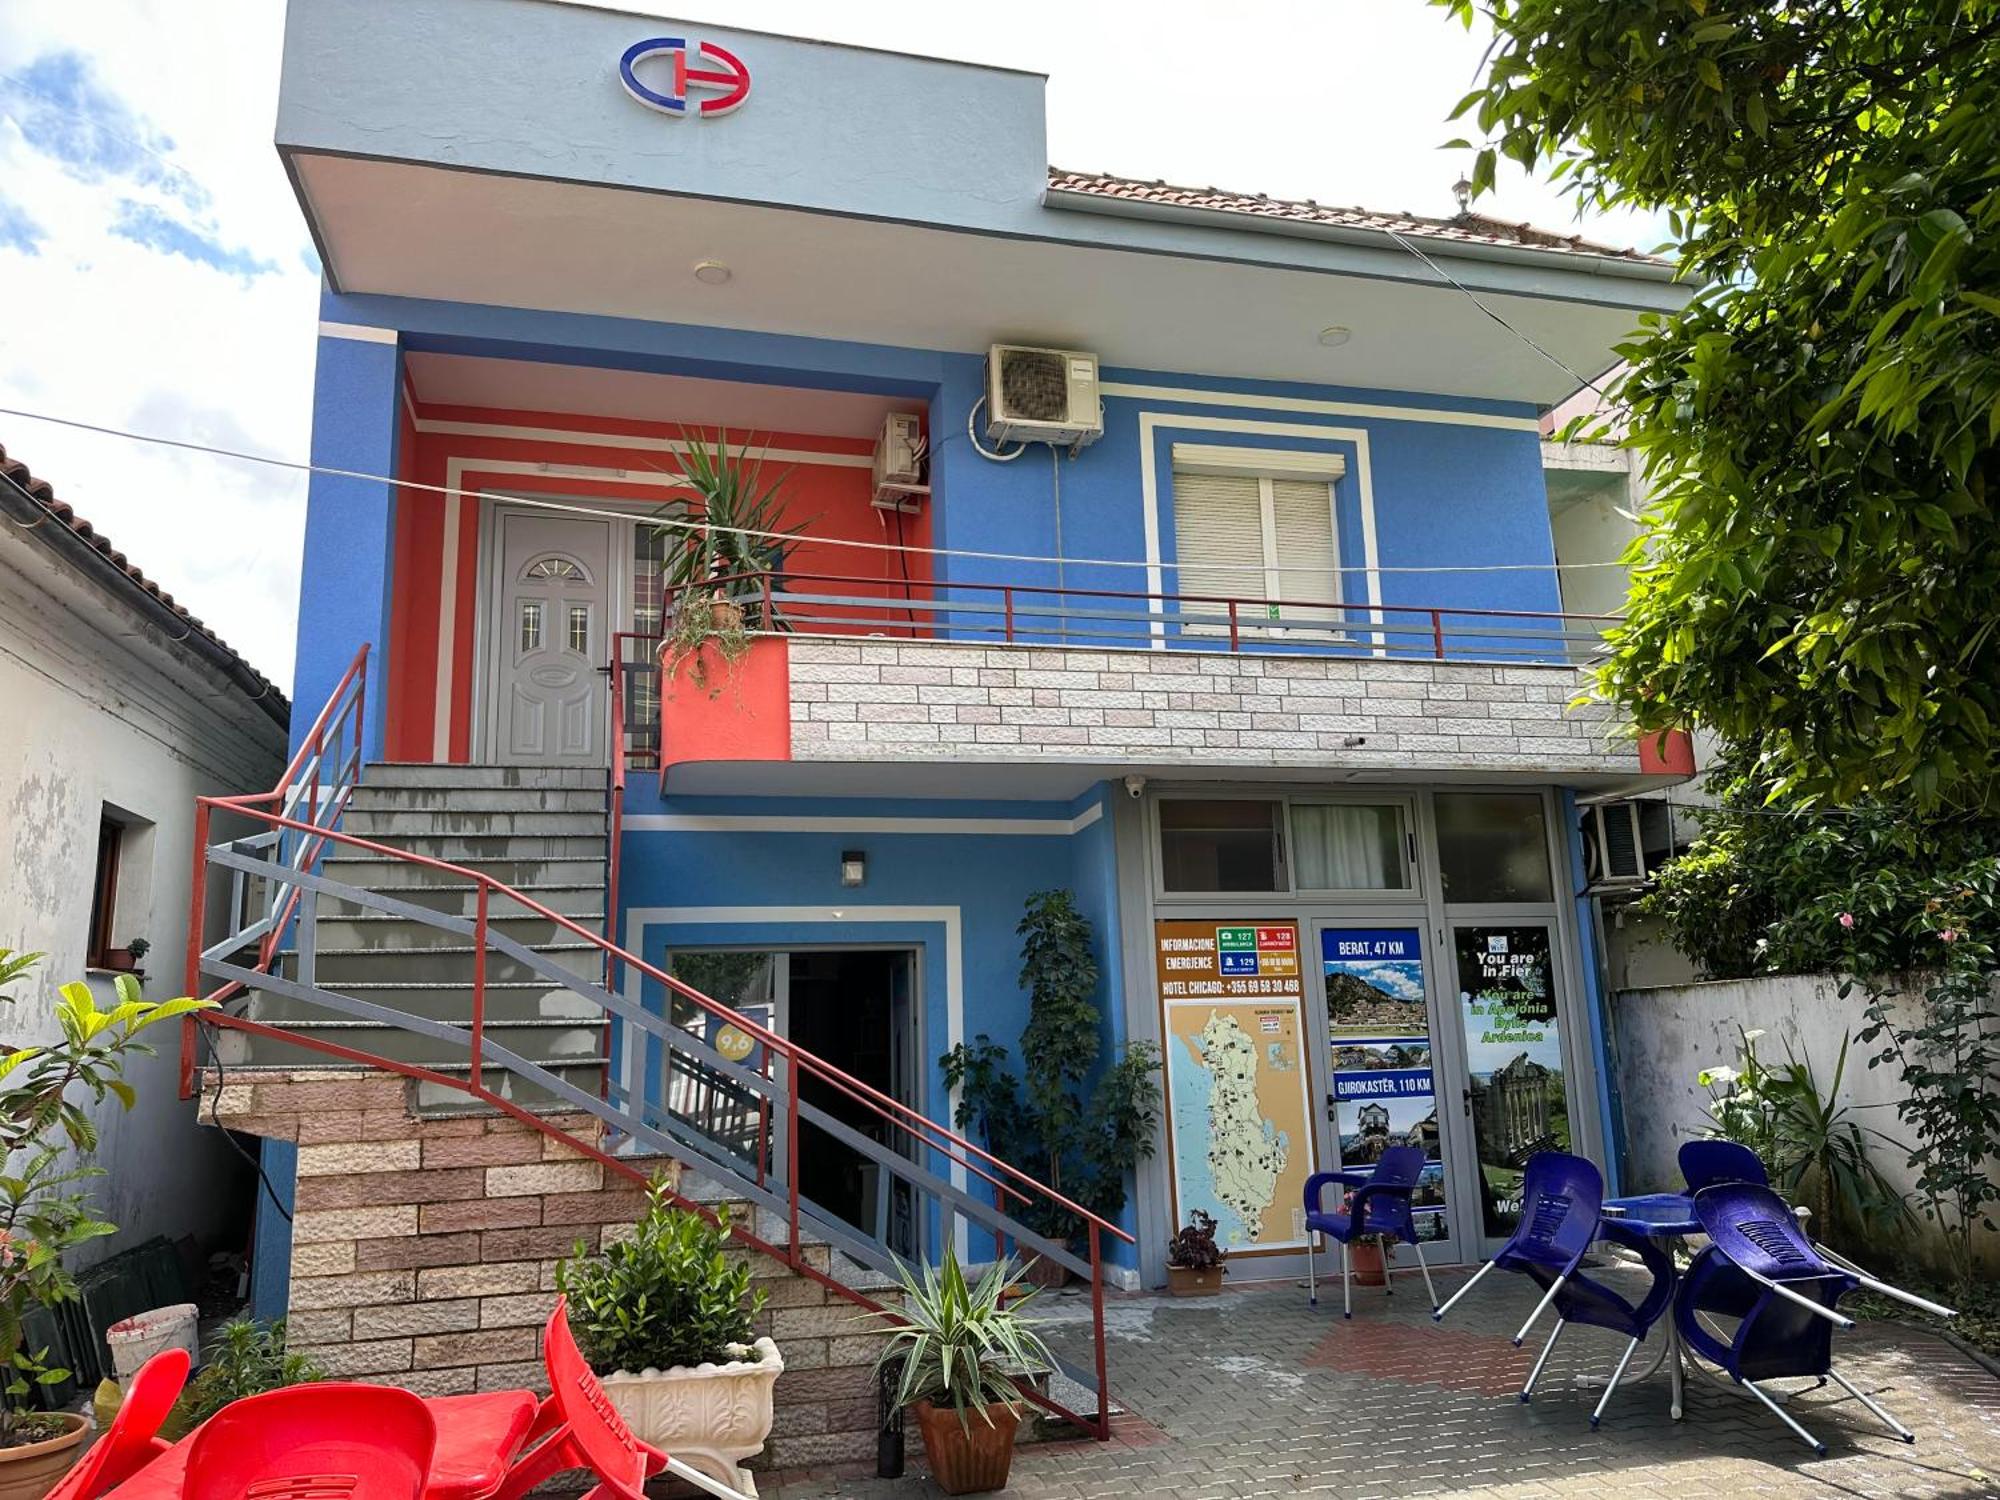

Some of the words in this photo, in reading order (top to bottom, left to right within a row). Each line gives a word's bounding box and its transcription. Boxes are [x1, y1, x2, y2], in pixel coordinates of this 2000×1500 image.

[1237, 932, 1252, 941] 127
[1338, 941, 1373, 956] BERAT,
[1374, 941, 1386, 955] 47
[1388, 941, 1405, 955] KM
[1239, 957, 1255, 967] 129
[1476, 951, 1506, 965] You
[1509, 954, 1535, 964] are
[1482, 964, 1497, 977] in
[1501, 964, 1532, 978] Fier
[1162, 981, 1188, 996] HOTEL
[1226, 979, 1247, 994] +355
[1481, 989, 1509, 1001] You
[1512, 990, 1536, 1001] are
[1399, 1078, 1416, 1092] 110
[1416, 1077, 1431, 1091] KM
